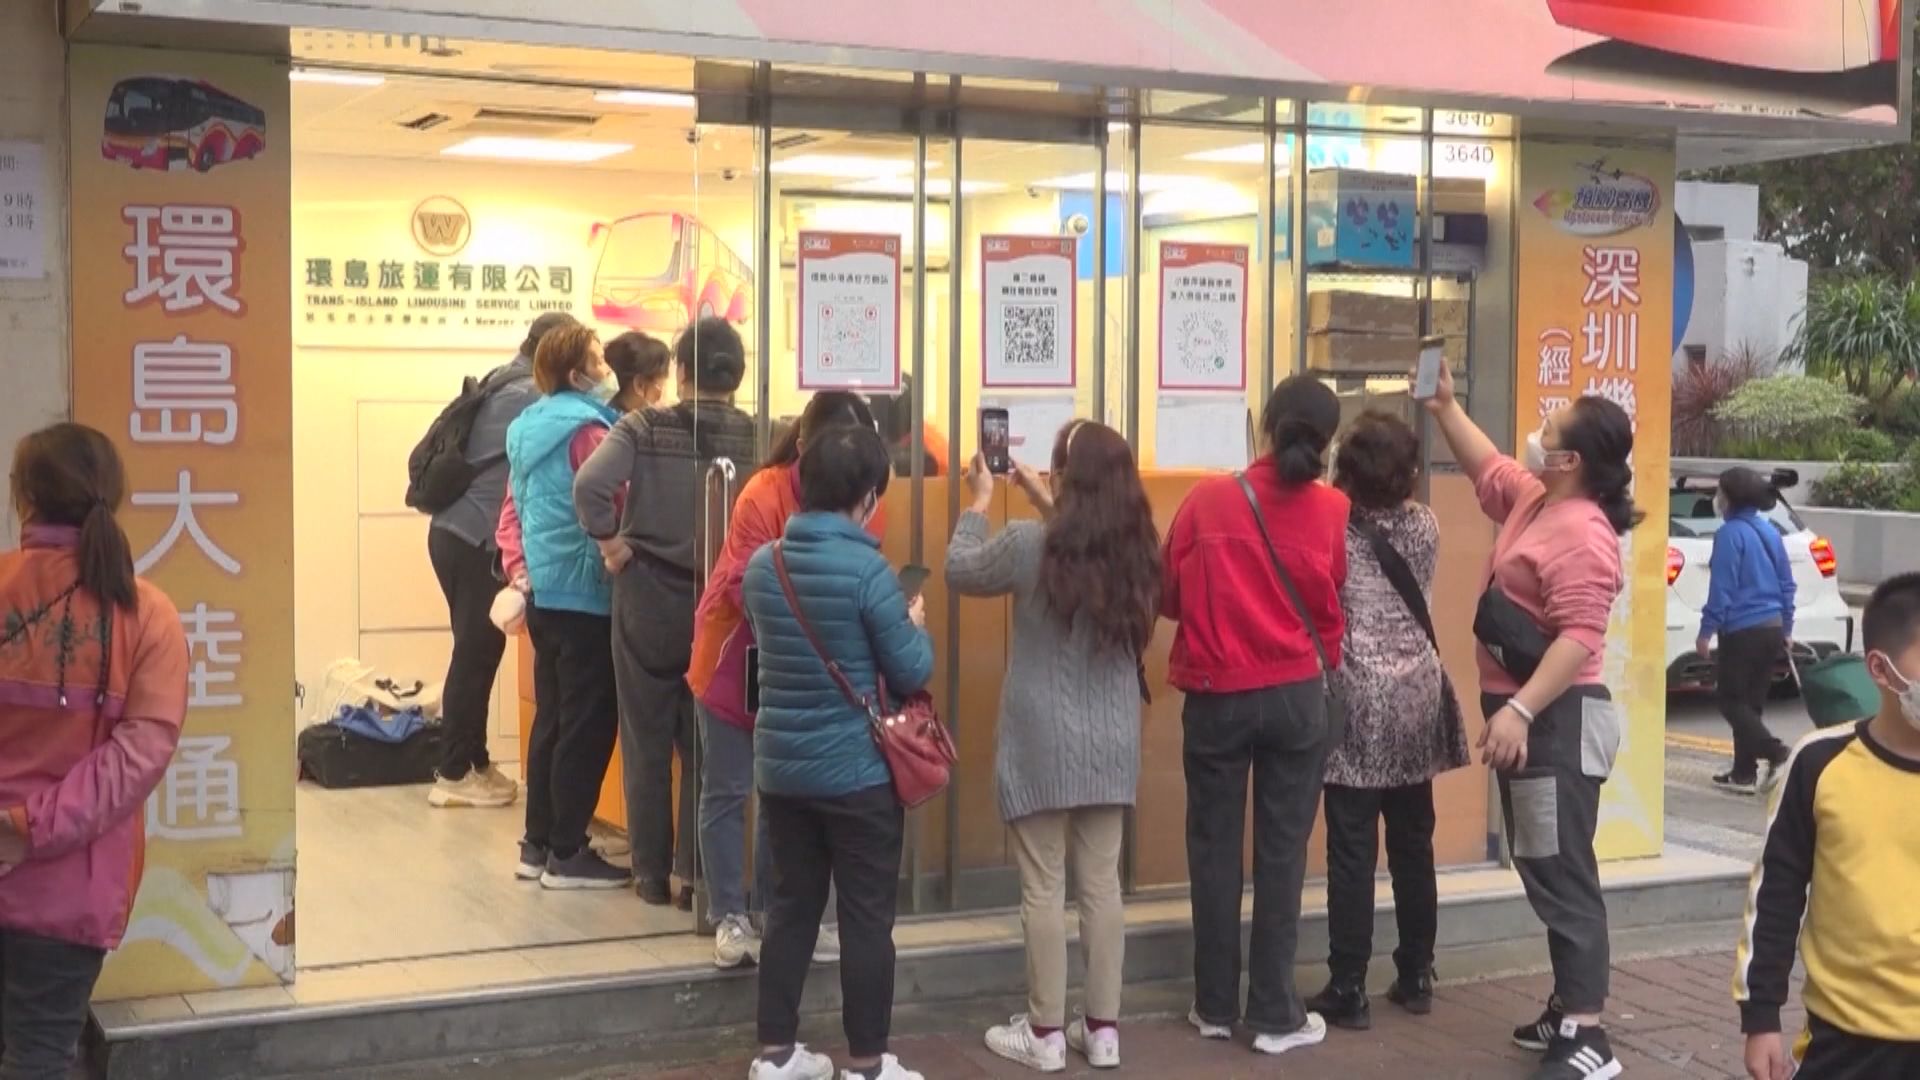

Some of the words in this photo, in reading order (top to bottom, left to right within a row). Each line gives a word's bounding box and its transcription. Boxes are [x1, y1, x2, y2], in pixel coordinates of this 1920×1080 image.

[1446, 145, 1494, 163] 364D
[306, 258, 573, 294] 環島旅運有限公司
[408, 298, 466, 309] LIMOUSINE
[476, 299, 521, 311] SERVICE
[529, 300, 573, 312] LIMITED
